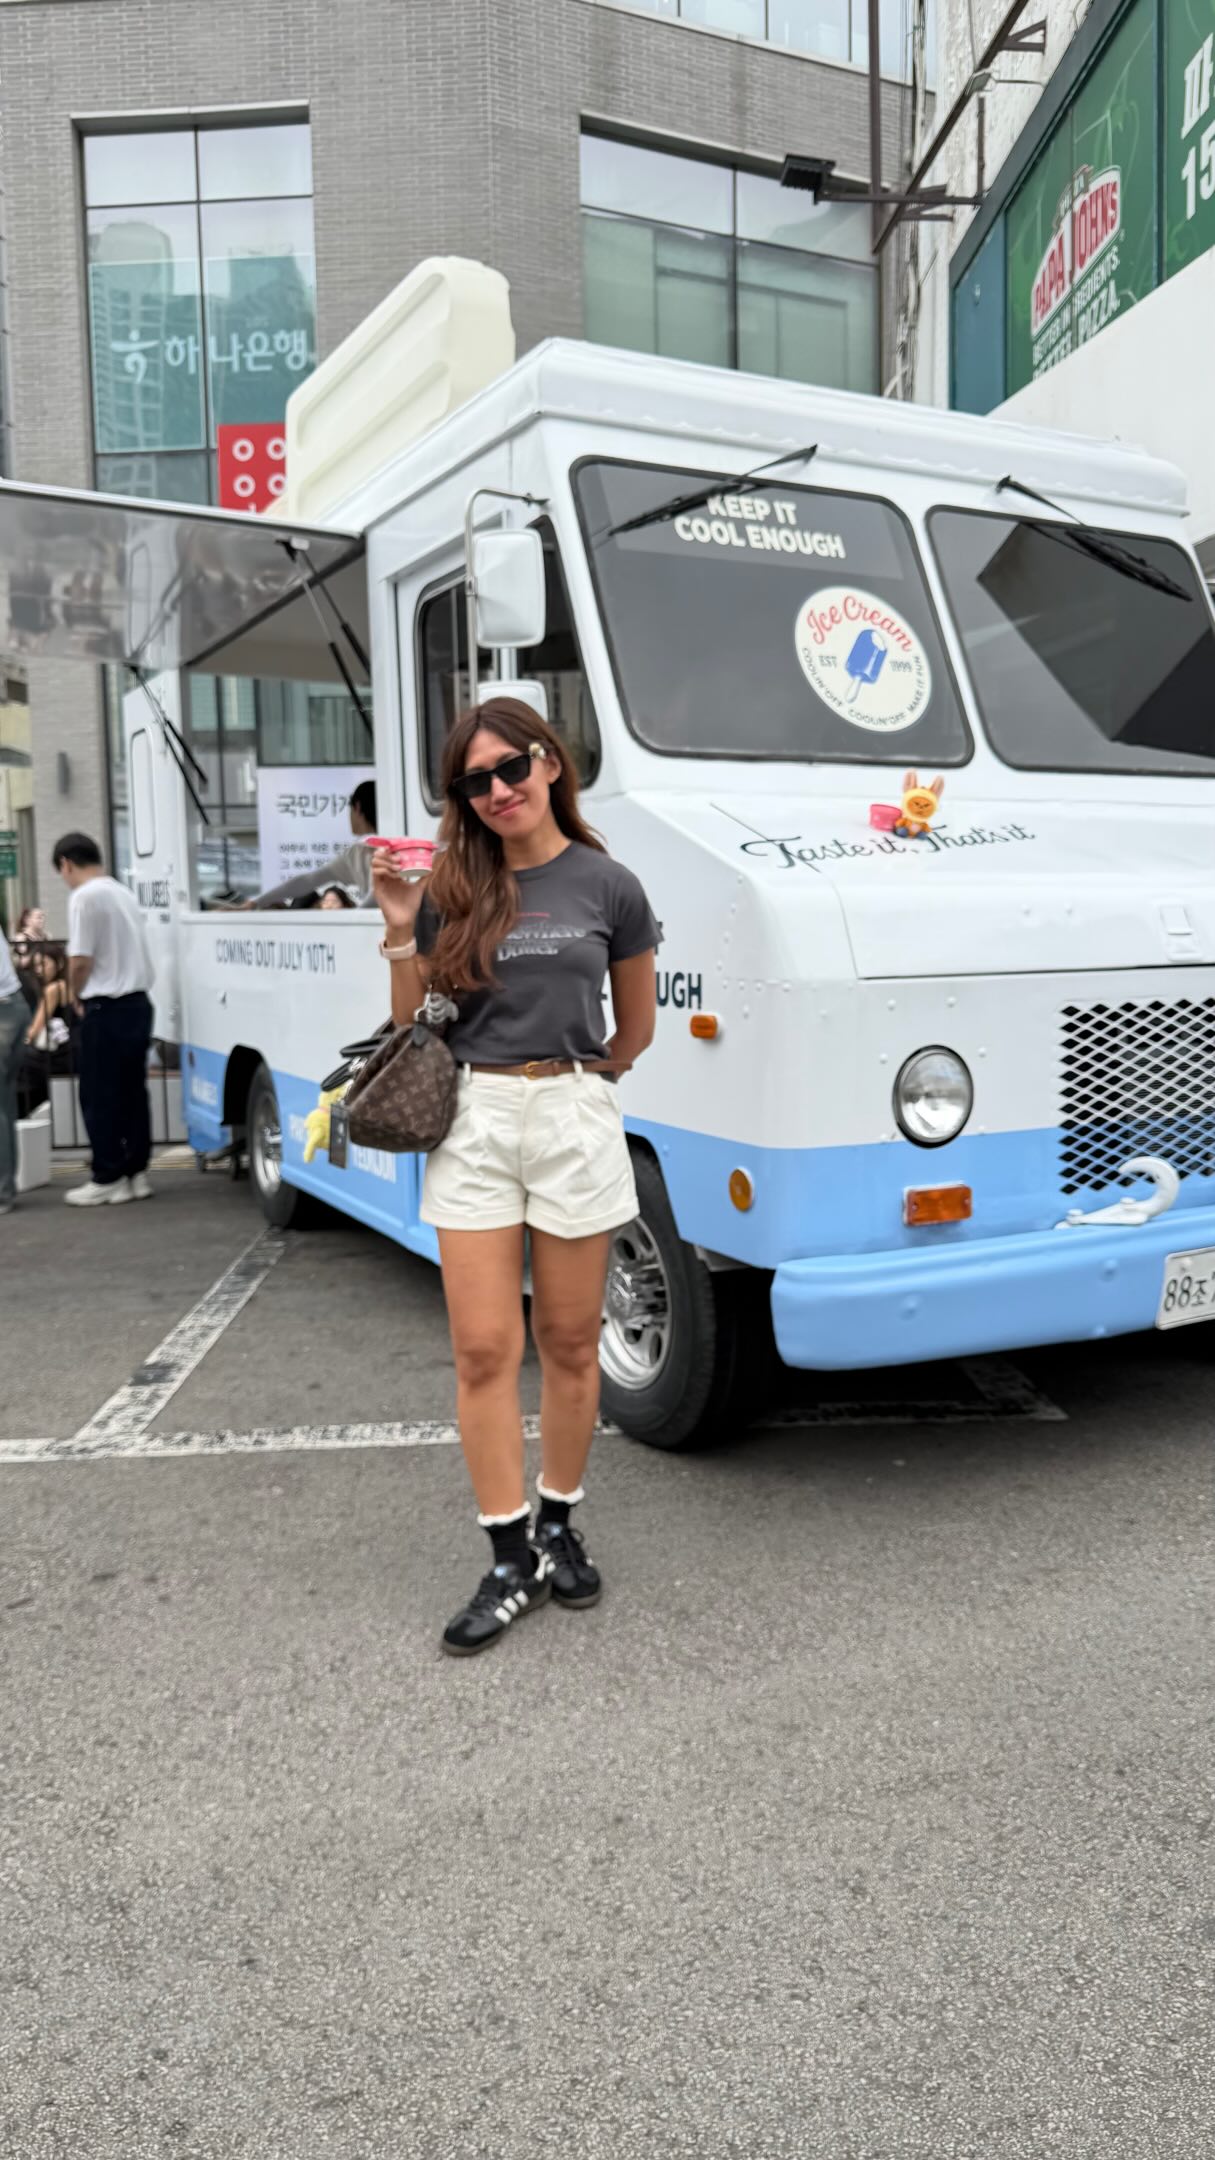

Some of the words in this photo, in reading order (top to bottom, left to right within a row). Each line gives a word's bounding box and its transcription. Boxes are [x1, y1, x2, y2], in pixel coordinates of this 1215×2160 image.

[1181, 32, 1215, 139] 파
[1033, 231, 1066, 328] PAPA
[164, 328, 309, 374] 하나은행
[707, 494, 771, 521] KEEP
[772, 501, 797, 525] IT
[674, 516, 746, 547] COOL
[745, 524, 846, 558] ENOUGH
[807, 605, 843, 645] Ice
[843, 595, 913, 653] Cream
[818, 655, 837, 668] EST
[741, 835, 873, 868] Taste
[1001, 823, 1036, 842] it
[216, 938, 252, 966] COMING
[255, 940, 275, 968] OUT
[278, 941, 304, 971] JULY
[306, 943, 336, 974] 10TH
[655, 971, 702, 1010] UGH
[1164, 1271, 1215, 1311] 88조
